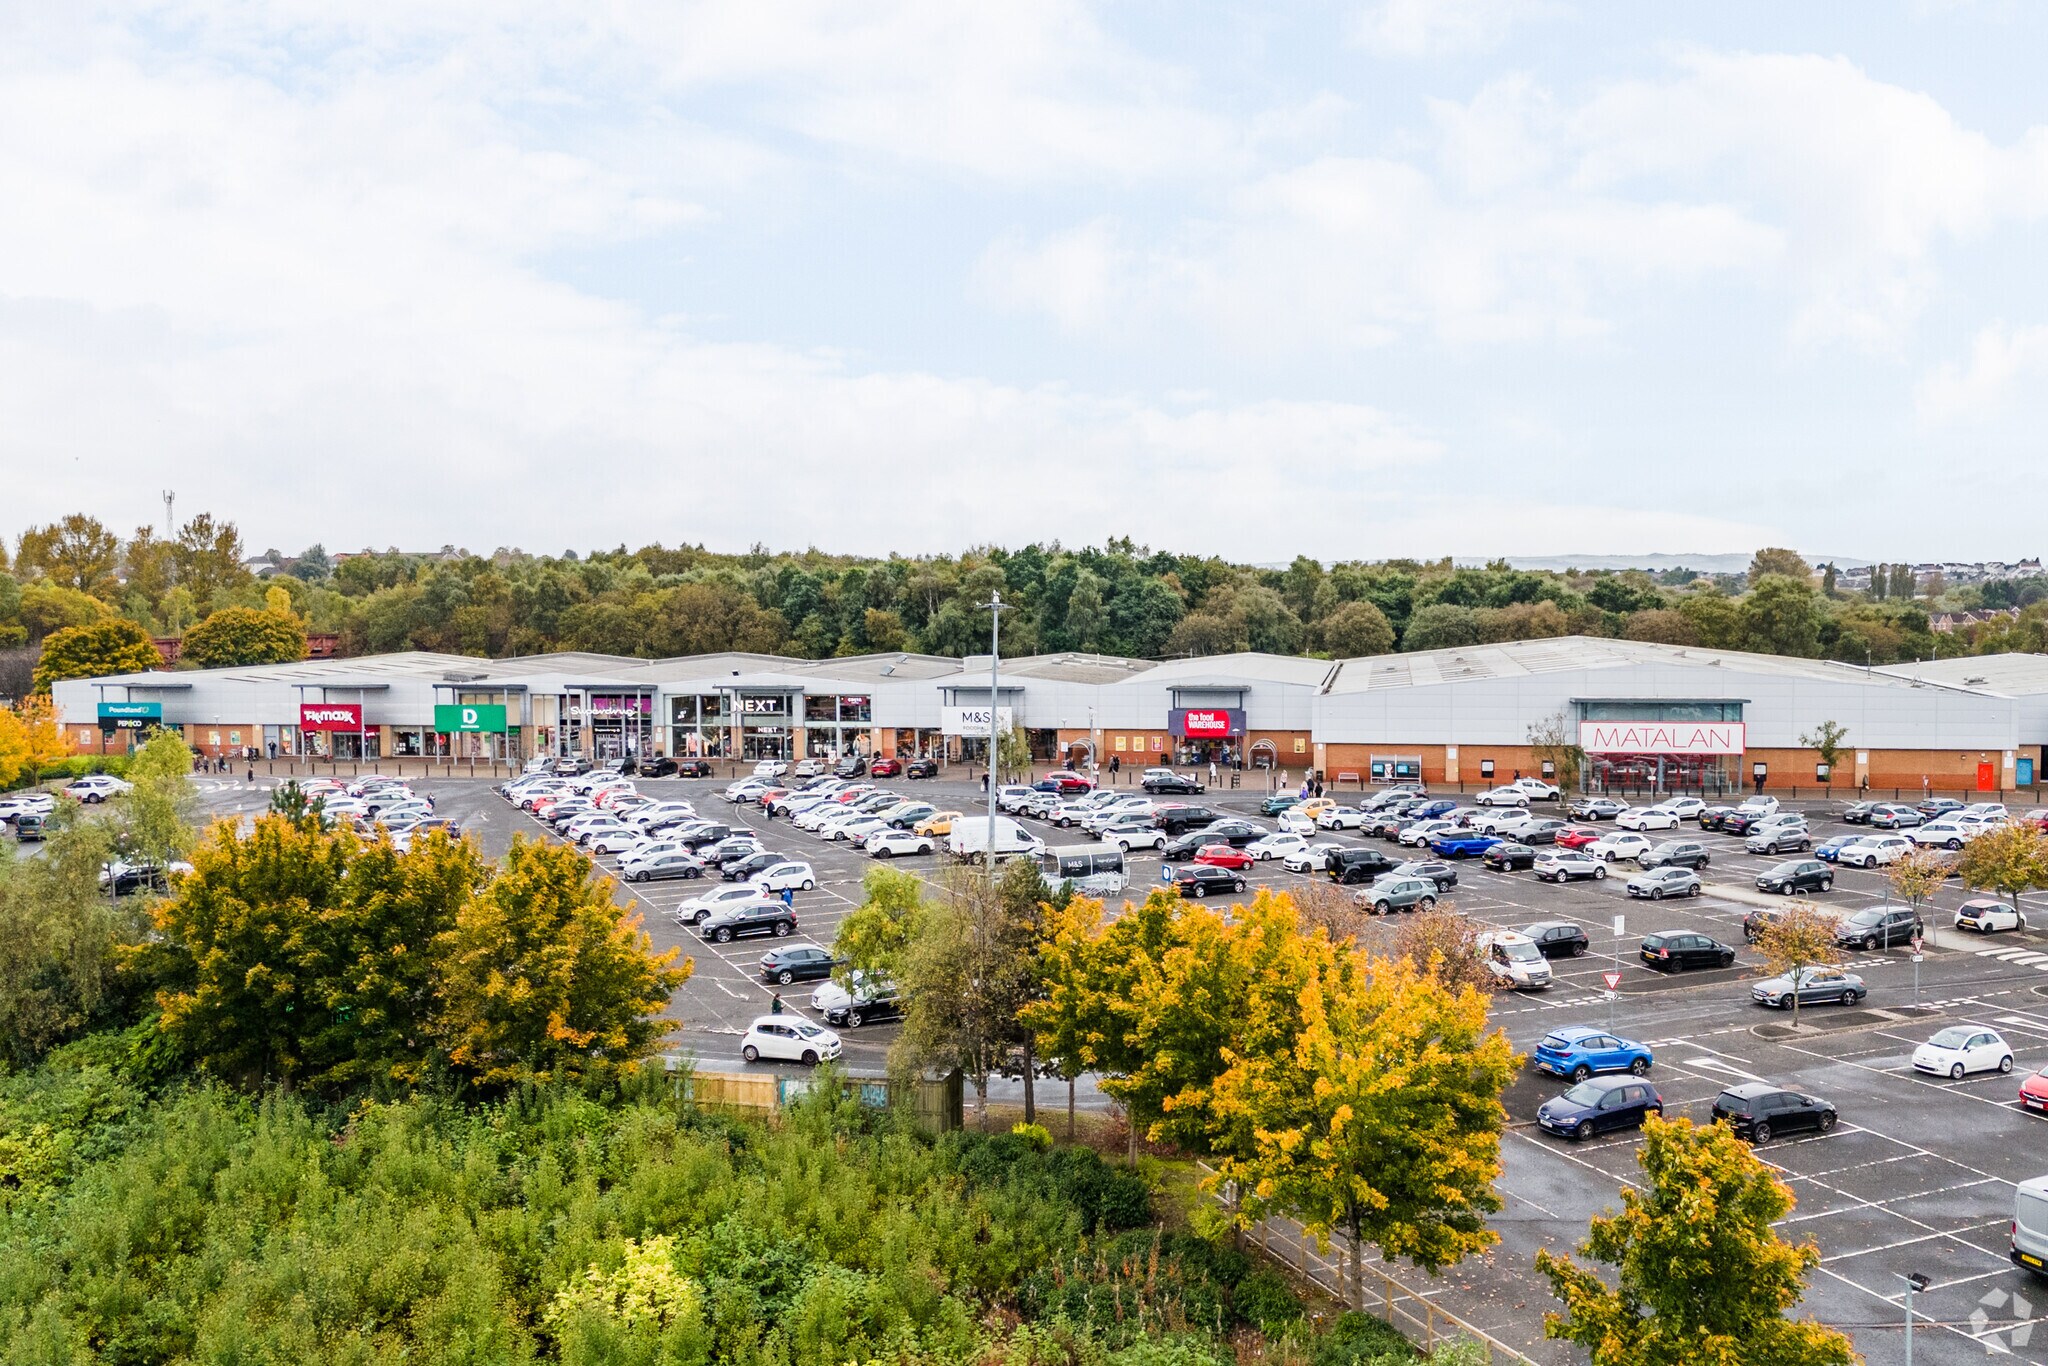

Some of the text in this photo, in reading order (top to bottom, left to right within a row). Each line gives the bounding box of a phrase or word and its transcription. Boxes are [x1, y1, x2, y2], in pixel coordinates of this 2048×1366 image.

[570, 705, 636, 718] Superdrug
[733, 699, 777, 712] NEXT
[462, 708, 478, 724] D
[962, 711, 991, 723] M&S
[1188, 712, 1214, 721] the food
[1188, 720, 1226, 729] WAREHOUSE
[1594, 728, 1730, 748] MATALAN
[1067, 860, 1083, 868] M&S
